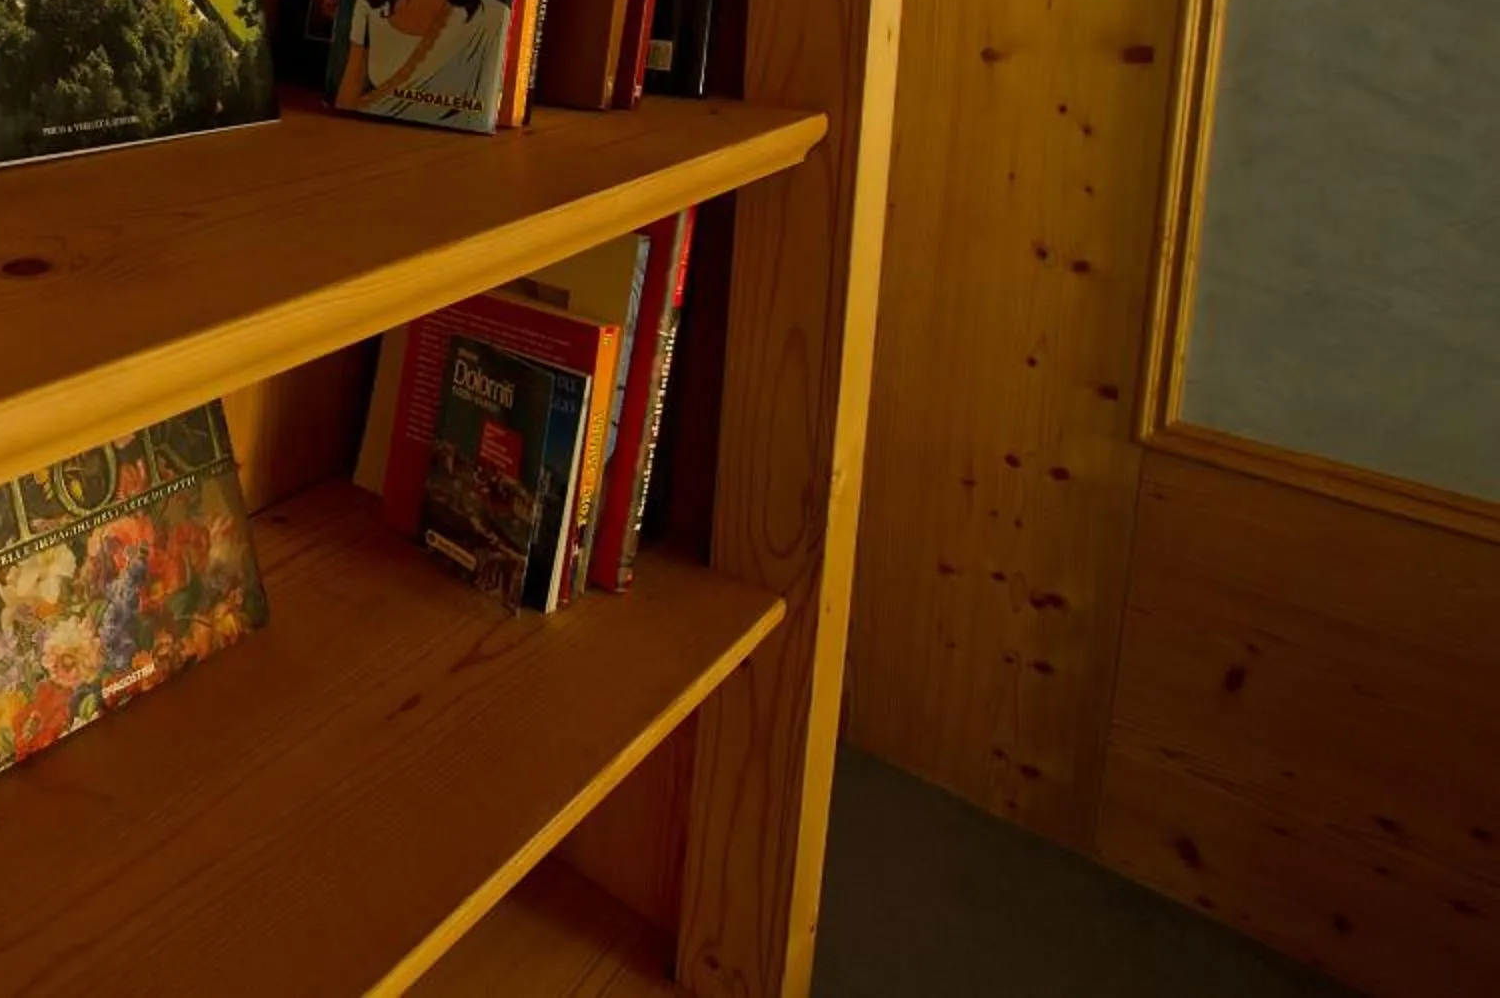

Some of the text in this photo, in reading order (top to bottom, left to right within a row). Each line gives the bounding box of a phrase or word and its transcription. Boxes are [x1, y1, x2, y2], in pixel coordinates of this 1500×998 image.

[393, 89, 483, 112] MADDALENA
[453, 358, 515, 410] Dolomiti
[33, 519, 92, 553] IMMAGINI
